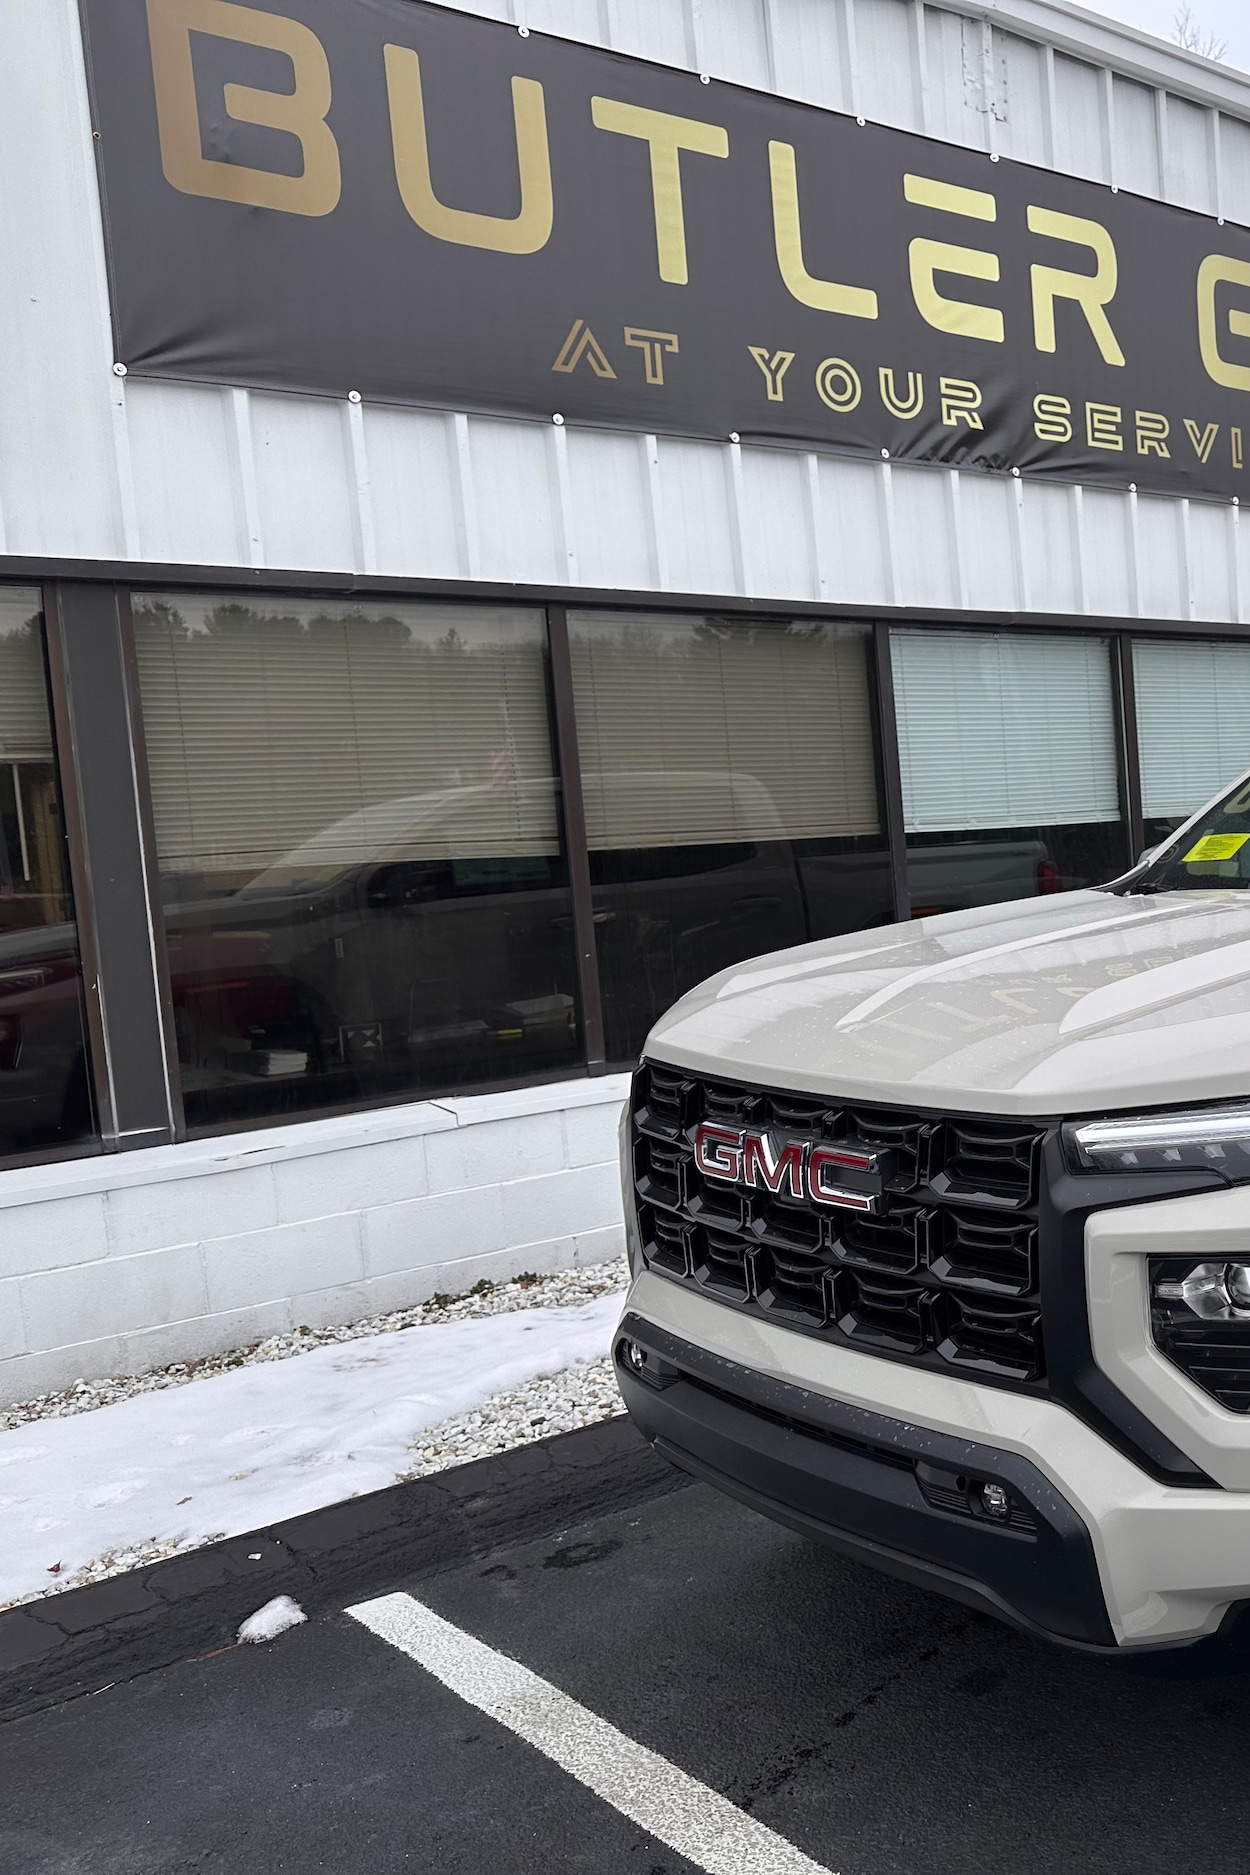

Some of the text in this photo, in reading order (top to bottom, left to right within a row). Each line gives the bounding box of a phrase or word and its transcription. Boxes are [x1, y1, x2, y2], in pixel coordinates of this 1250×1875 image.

[145, 0, 1126, 367] BUTLER
[551, 319, 680, 385] AT
[747, 346, 985, 431] YOUR
[694, 1121, 878, 1212] GMC
